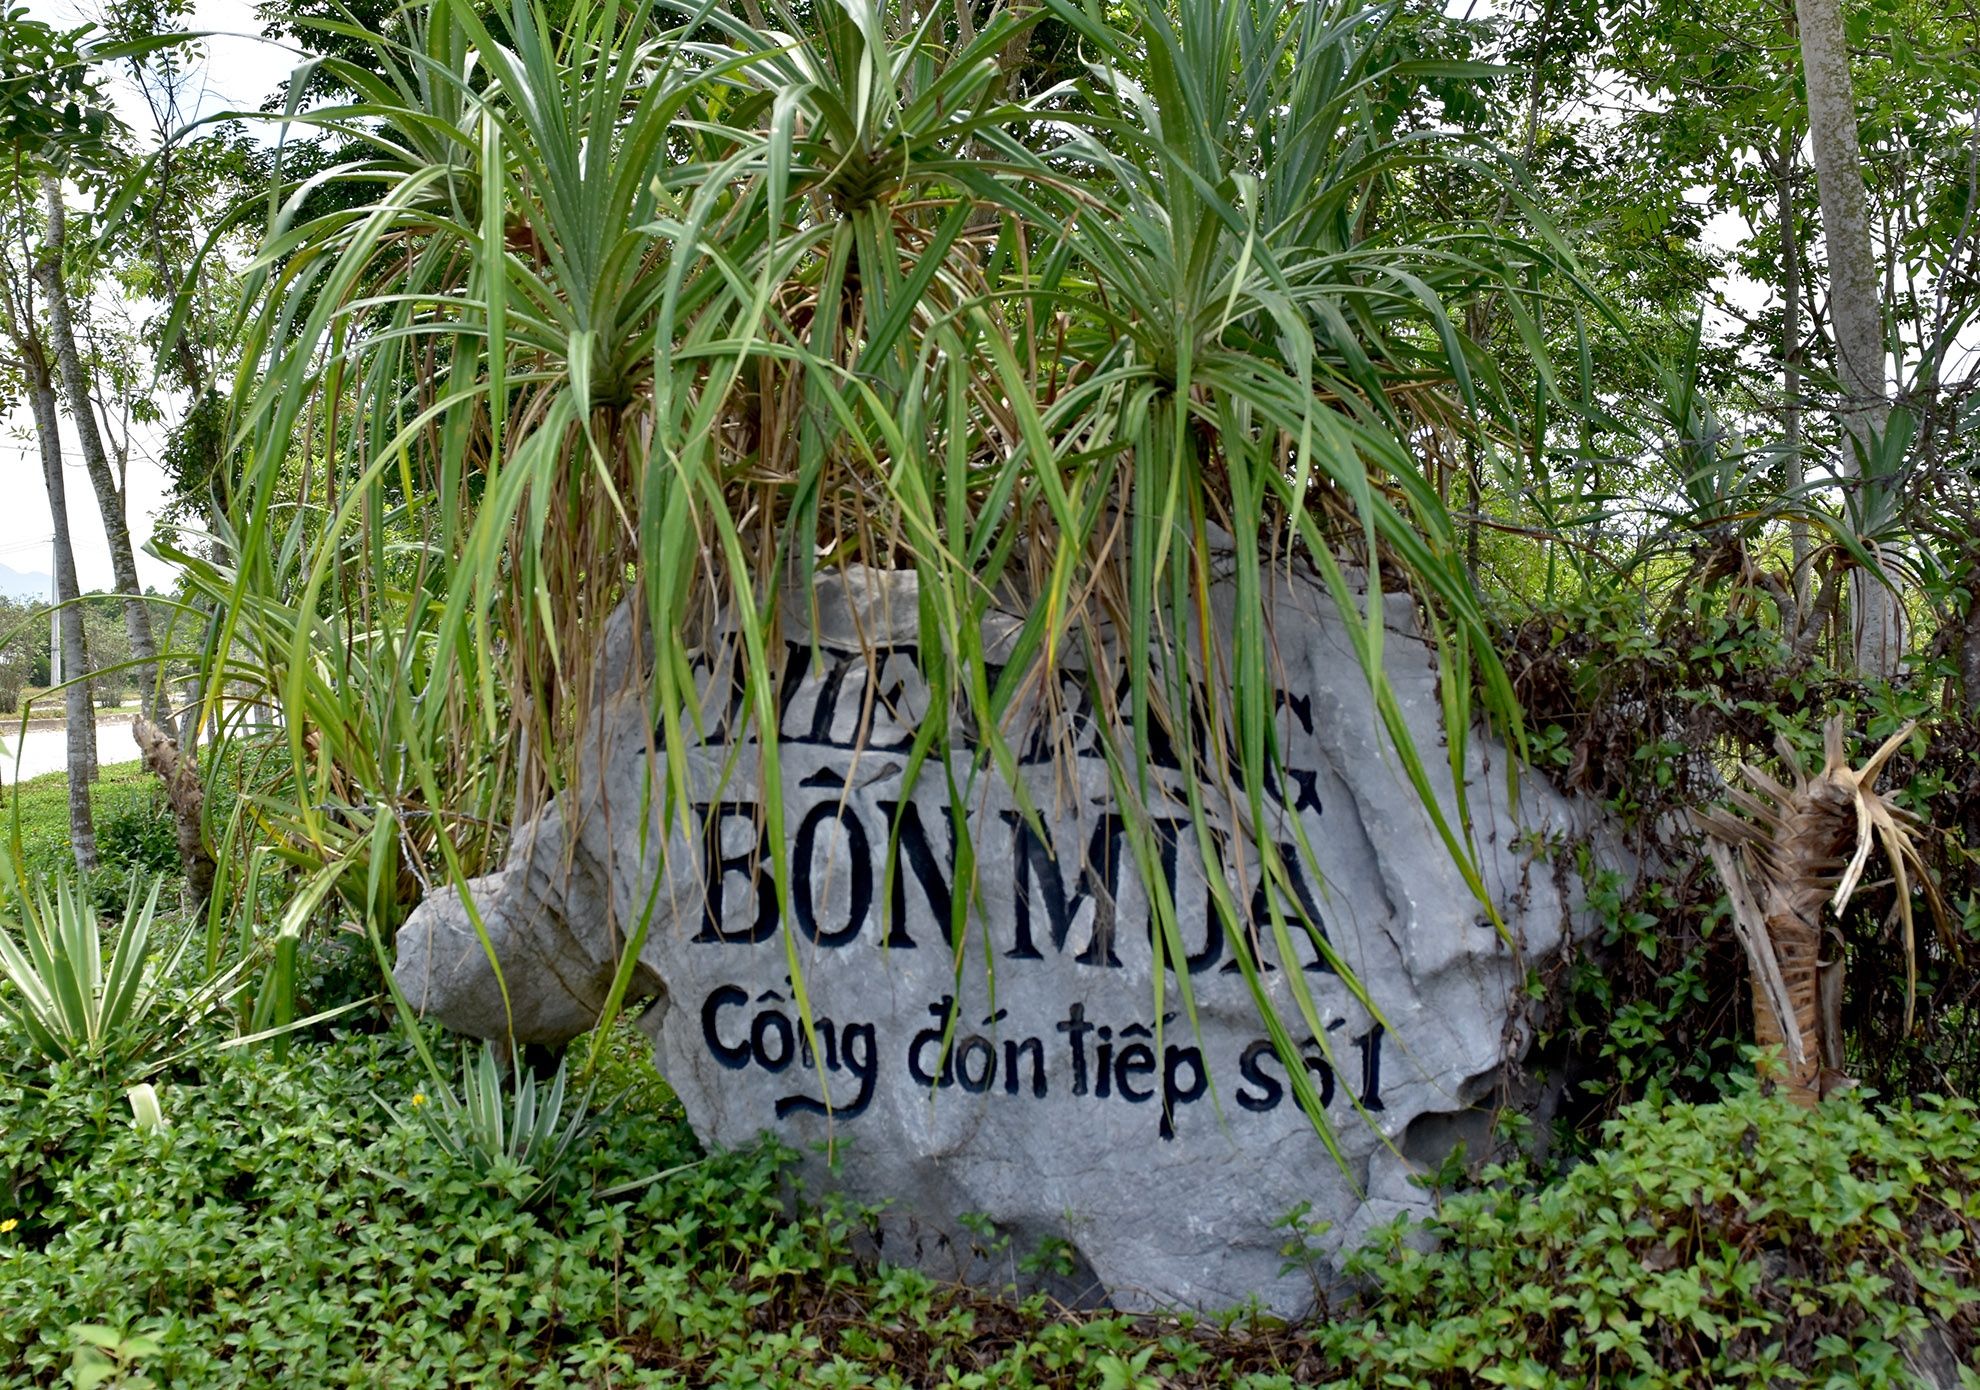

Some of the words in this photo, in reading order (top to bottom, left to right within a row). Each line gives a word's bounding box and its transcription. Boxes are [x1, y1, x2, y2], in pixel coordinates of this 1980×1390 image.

[908, 995, 1048, 1099] đón
[1056, 1002, 1208, 1141] tiếp
[1236, 1017, 1346, 1112] số
